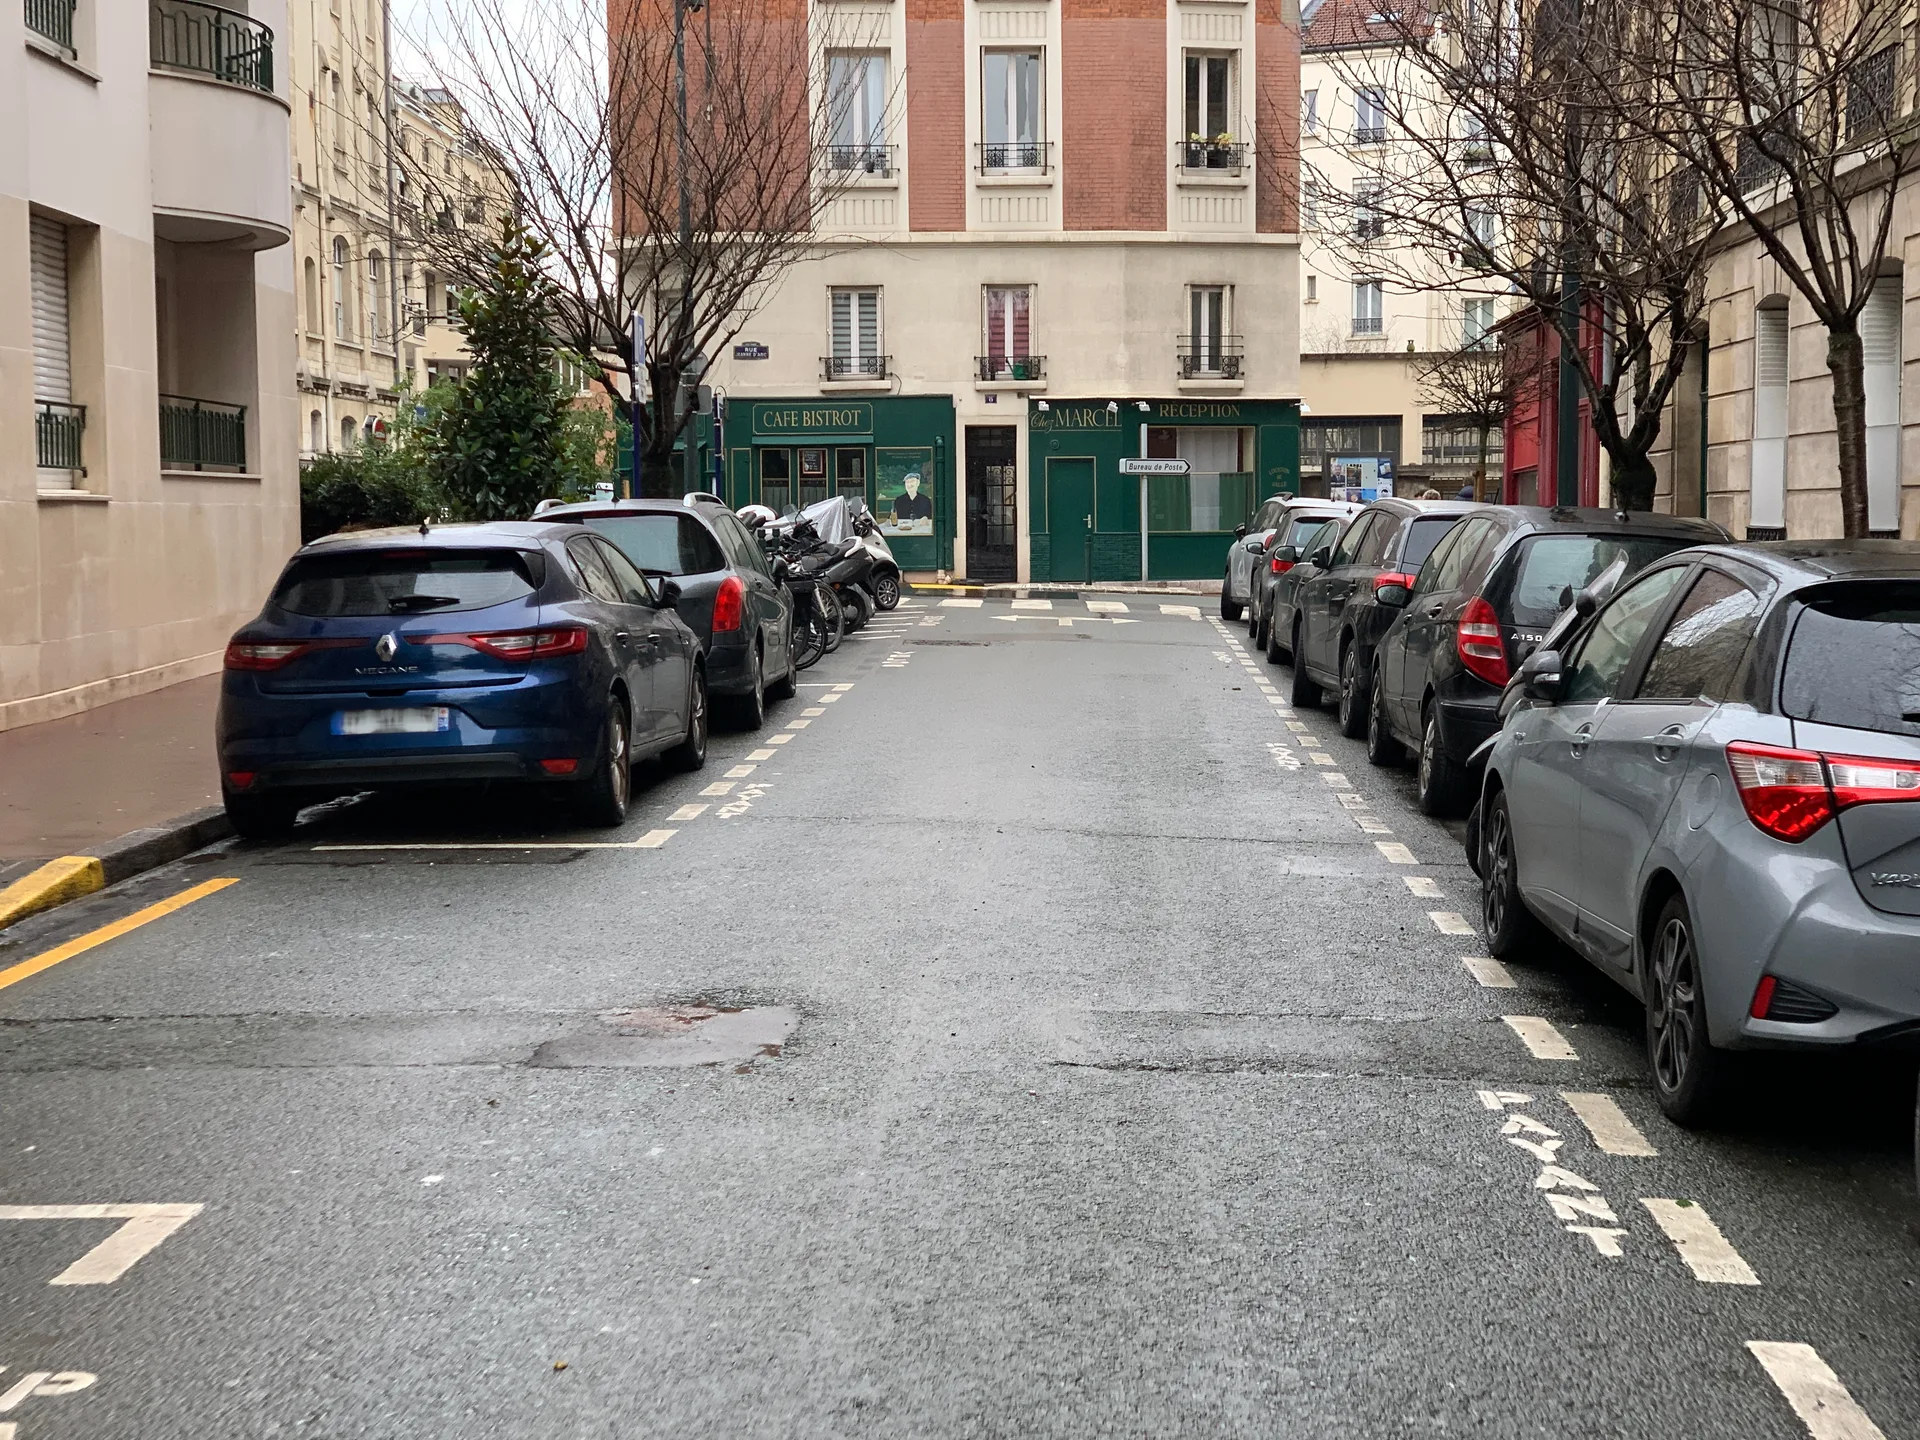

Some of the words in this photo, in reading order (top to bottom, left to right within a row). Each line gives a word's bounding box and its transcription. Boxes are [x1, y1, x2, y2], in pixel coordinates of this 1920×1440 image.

[763, 411, 799, 427] CAFE
[803, 410, 862, 427] BISTROT
[1029, 410, 1054, 433] Chez
[1055, 408, 1122, 427] MARCEL
[1128, 463, 1152, 471] Bureau
[1153, 463, 1162, 471] de
[1164, 463, 1183, 471] Poste
[355, 666, 418, 675] MEGANE
[1476, 1090, 1629, 1257] PAYANT
